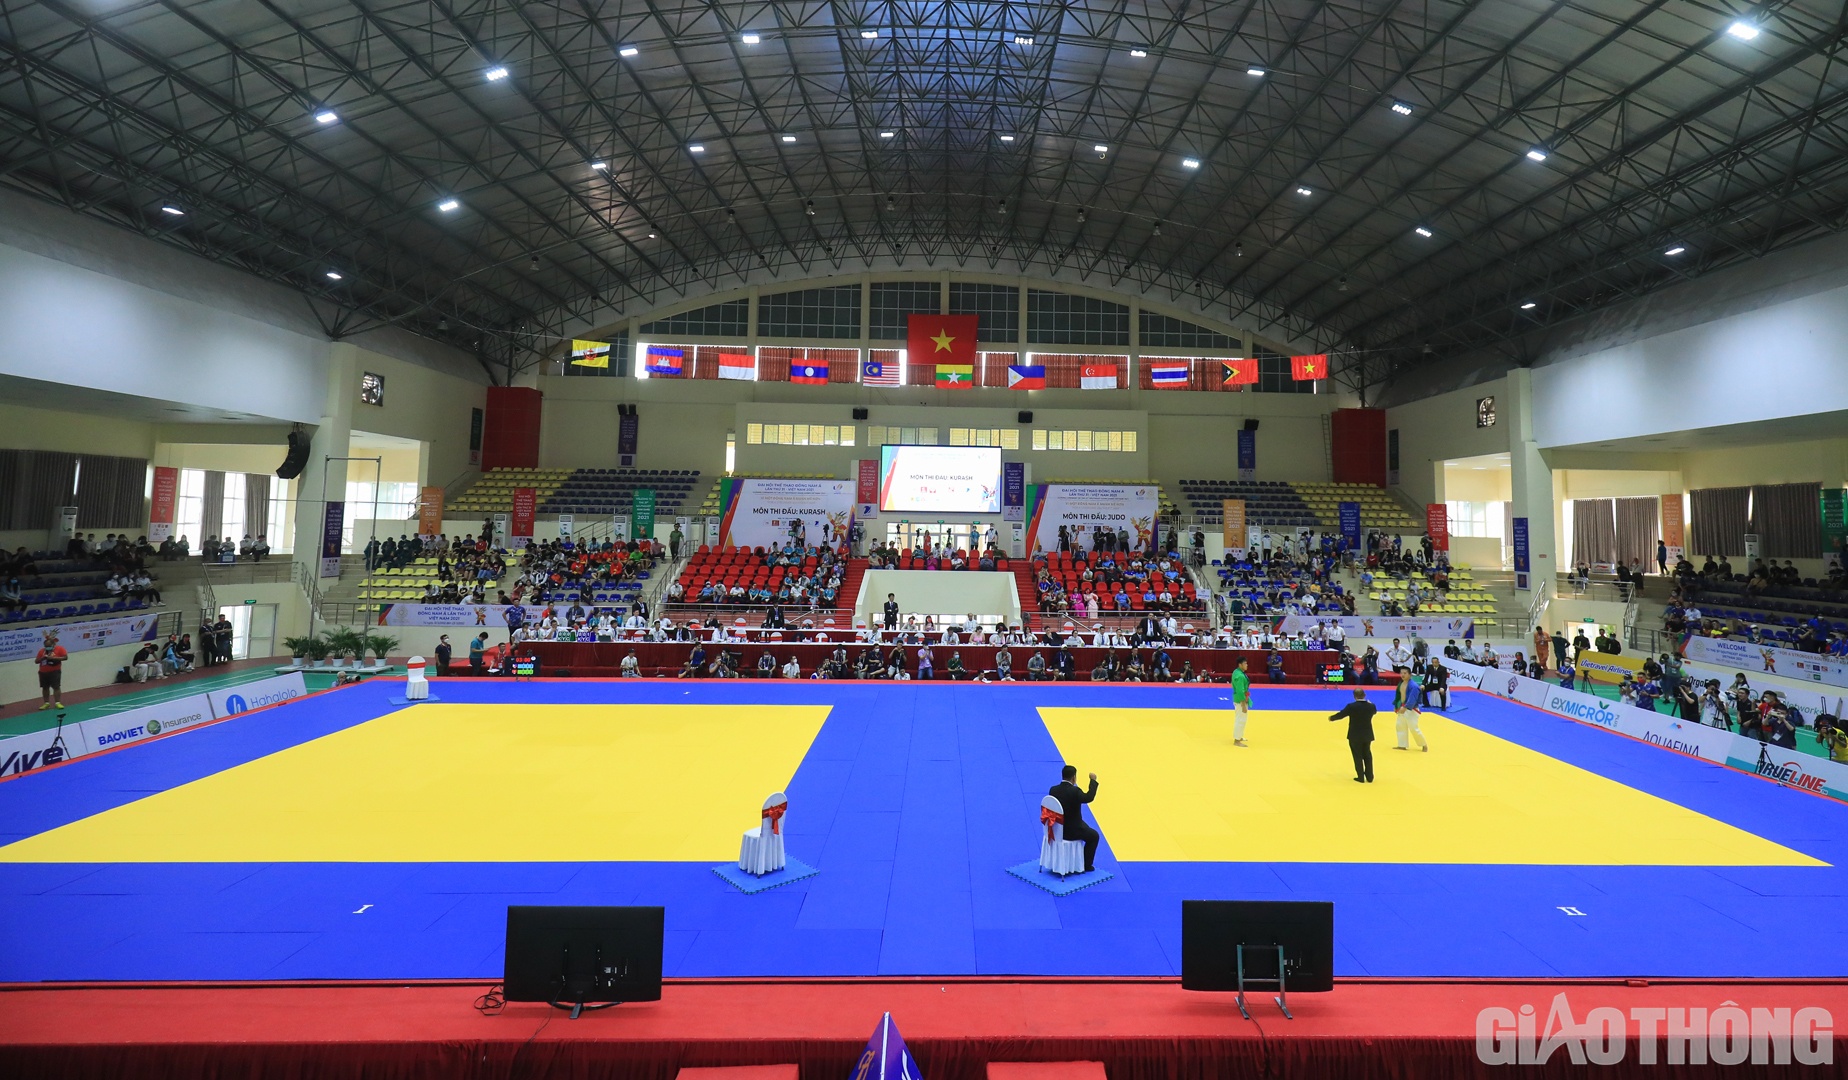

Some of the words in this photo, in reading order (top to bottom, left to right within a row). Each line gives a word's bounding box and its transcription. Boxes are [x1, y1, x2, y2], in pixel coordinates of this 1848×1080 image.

[1091, 512, 1106, 520] ĐẤU:
[1717, 642, 1746, 652] WELCOME
[1581, 660, 1608, 672] Vietravel
[1607, 666, 1632, 675] Airlines
[250, 688, 297, 708] Hahalolo
[98, 726, 144, 745] BAOVIET
[162, 713, 202, 729] Insurance
